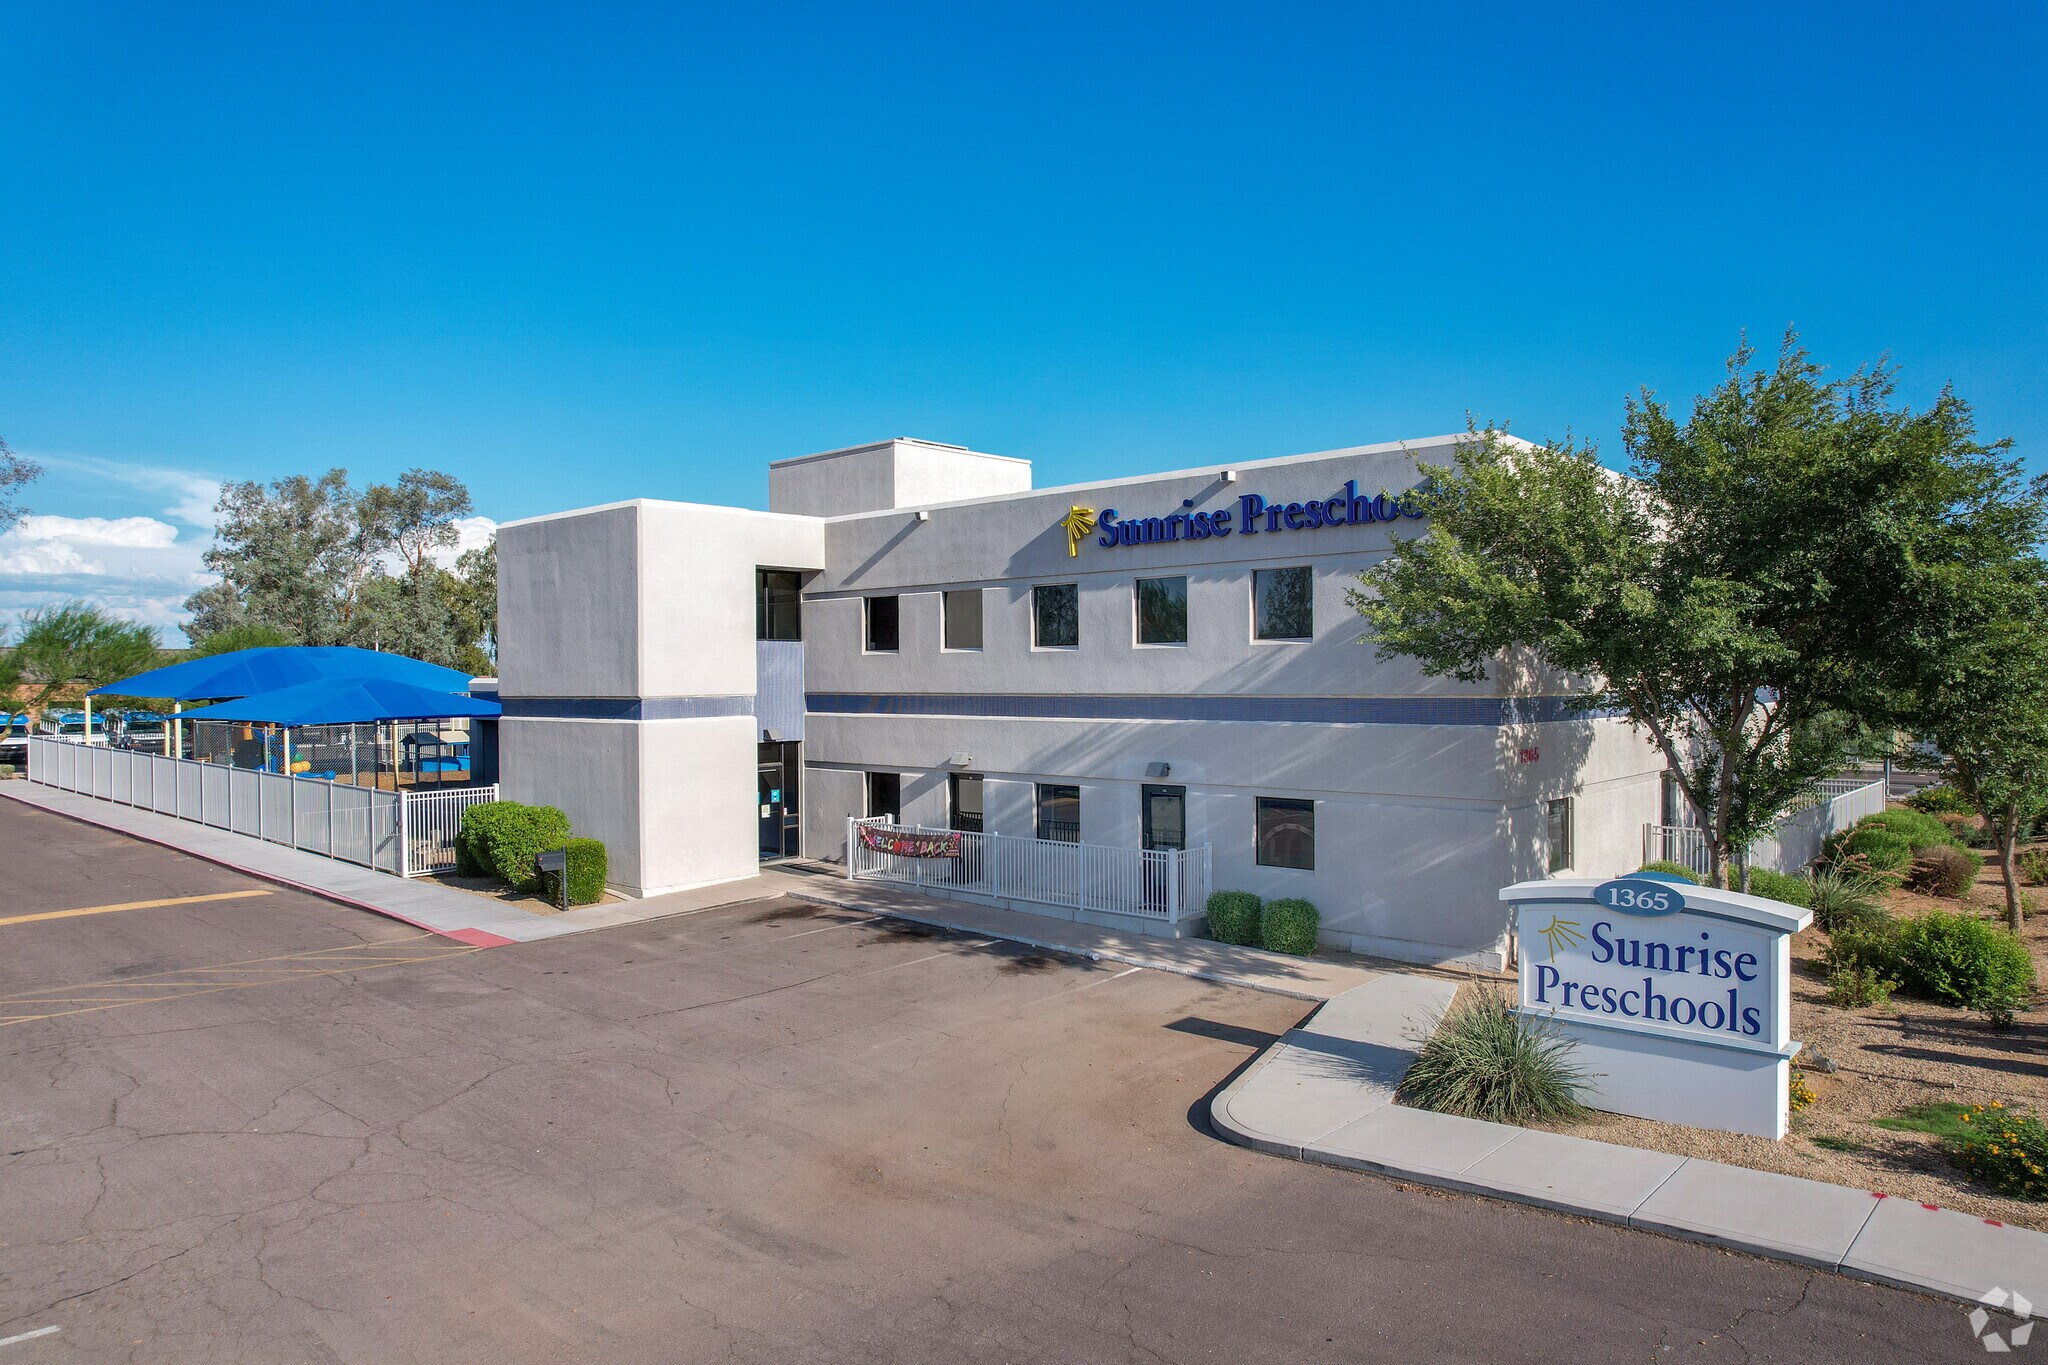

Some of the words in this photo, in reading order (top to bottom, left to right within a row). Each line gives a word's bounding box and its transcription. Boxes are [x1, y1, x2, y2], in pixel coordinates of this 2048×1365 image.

[1099, 499, 1231, 548] Sunrise
[1239, 479, 1465, 535] Preschoo
[1520, 747, 1539, 763] 1365
[1608, 887, 1669, 911] 1365
[1591, 922, 1758, 982] Sunrise
[1534, 964, 1761, 1036] Preschools
